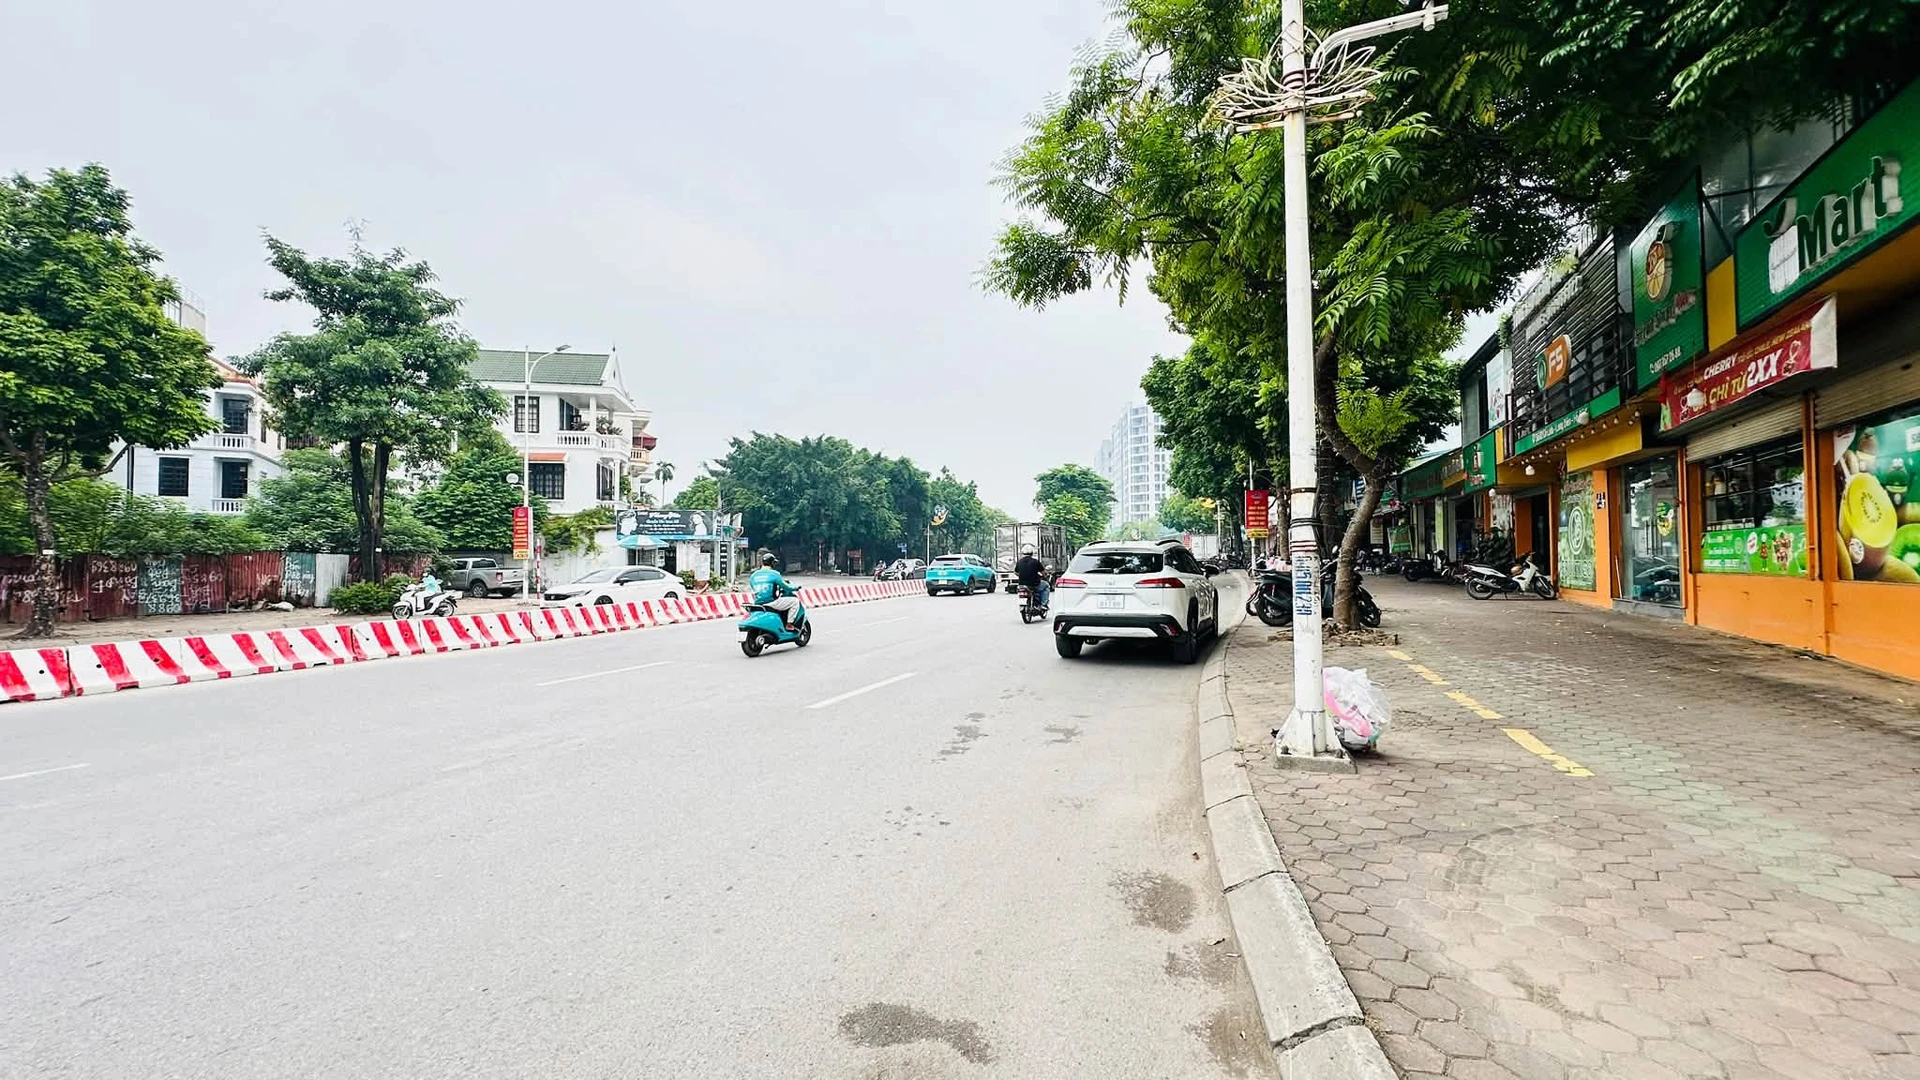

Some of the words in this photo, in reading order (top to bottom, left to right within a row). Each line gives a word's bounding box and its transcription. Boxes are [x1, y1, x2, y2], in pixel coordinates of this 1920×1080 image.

[1796, 156, 1896, 273] Mart
[1704, 352, 1738, 380] CHERRY
[1709, 376, 1730, 404] CHỈ
[1746, 348, 1783, 388] 2XX
